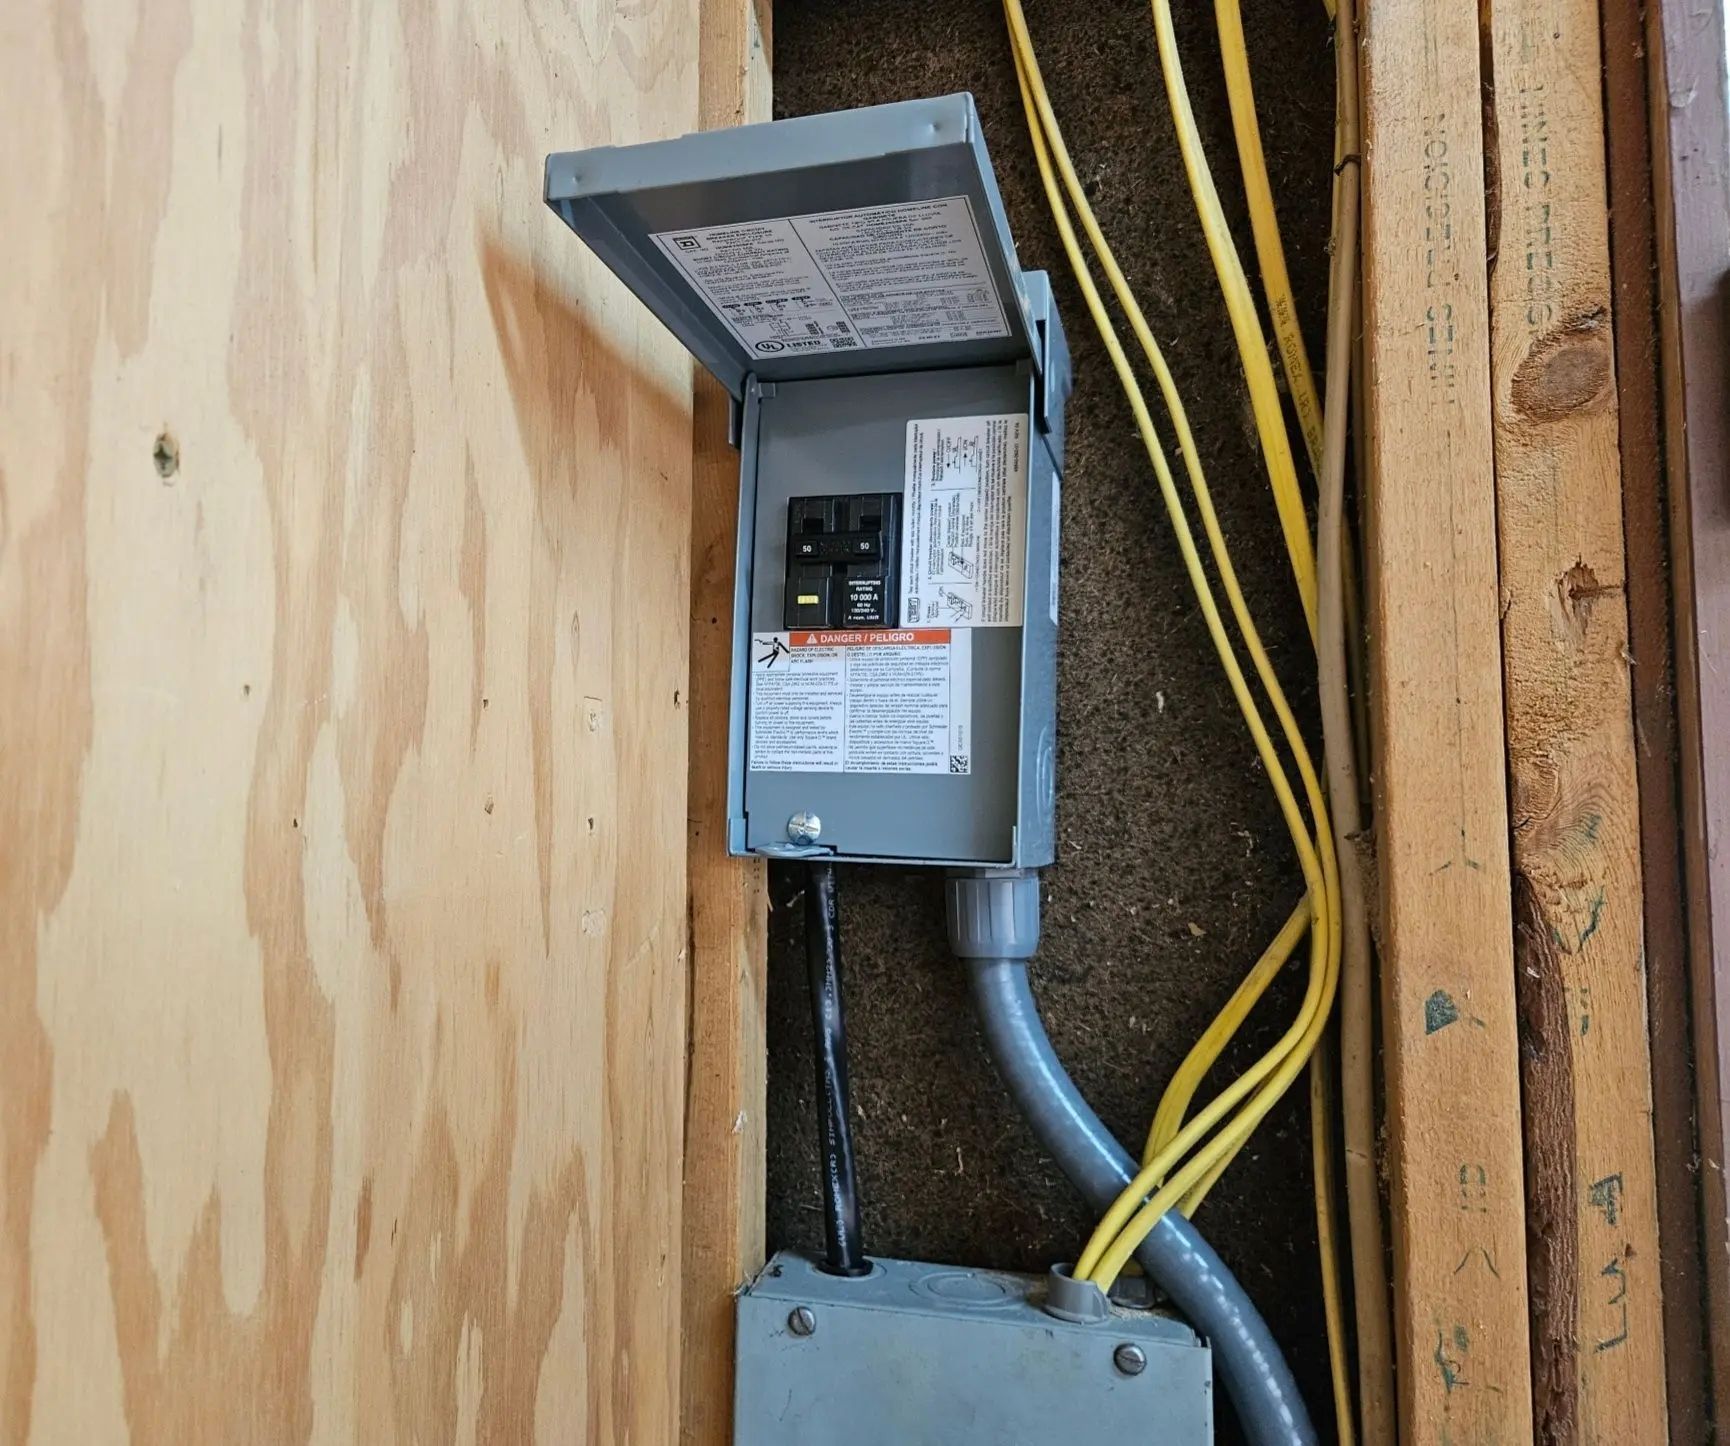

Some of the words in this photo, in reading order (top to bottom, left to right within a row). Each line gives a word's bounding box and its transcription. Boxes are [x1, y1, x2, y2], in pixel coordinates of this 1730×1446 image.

[802, 545, 812, 553] 50
[860, 542, 870, 550] 50
[850, 593, 858, 601] 10
[859, 593, 872, 601] 000
[873, 593, 879, 601] A
[820, 634, 862, 643] DANGER
[869, 632, 915, 642] PELIGRO
